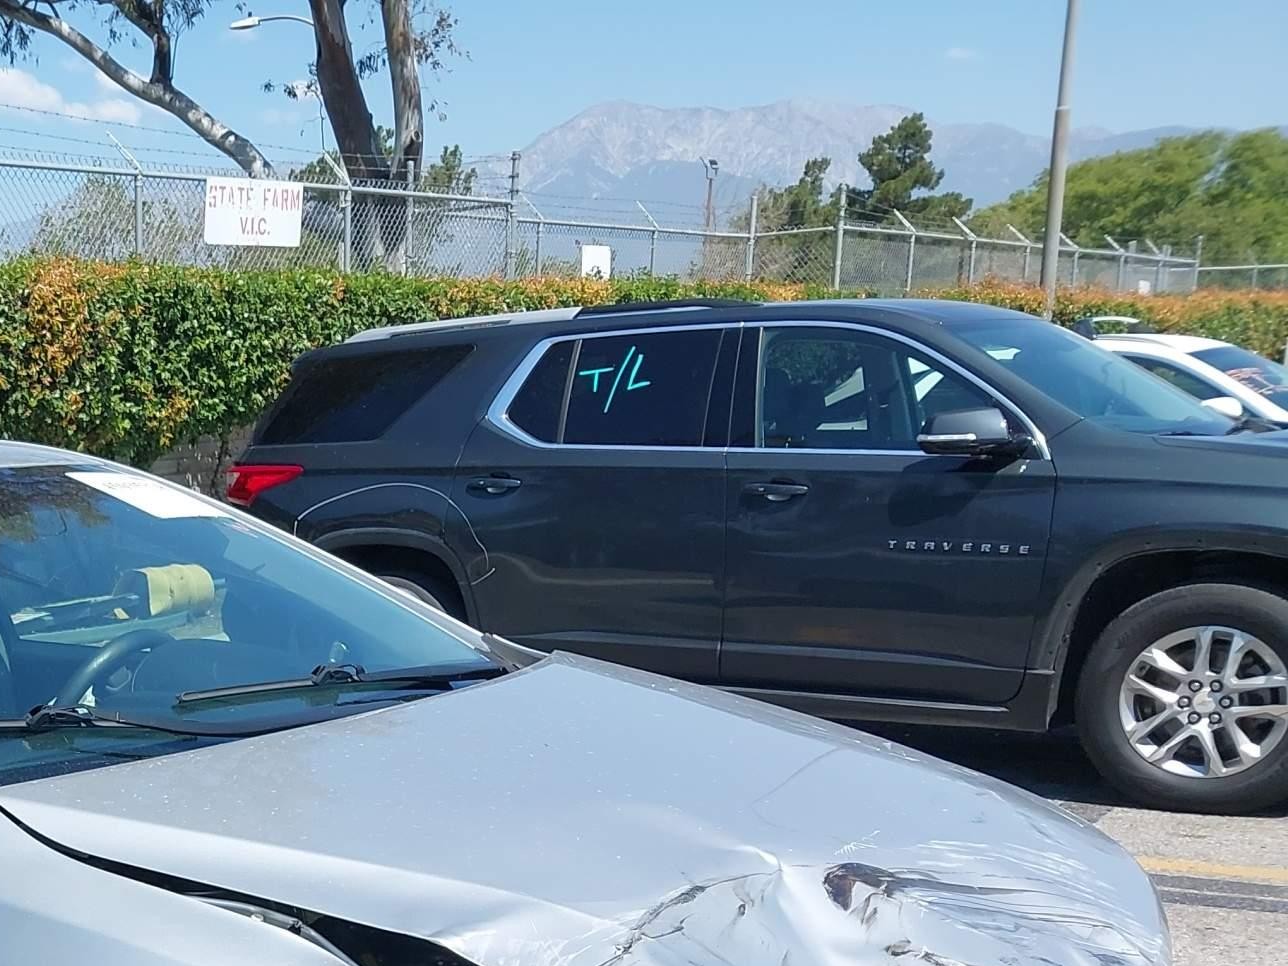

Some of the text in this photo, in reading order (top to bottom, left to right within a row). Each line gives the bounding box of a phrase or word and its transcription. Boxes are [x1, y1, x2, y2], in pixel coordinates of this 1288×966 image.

[208, 185, 301, 211] STATE FARM
[239, 216, 271, 235] V.I.C.
[579, 345, 651, 413] T/L
[888, 540, 1029, 554] TRAVERSE
